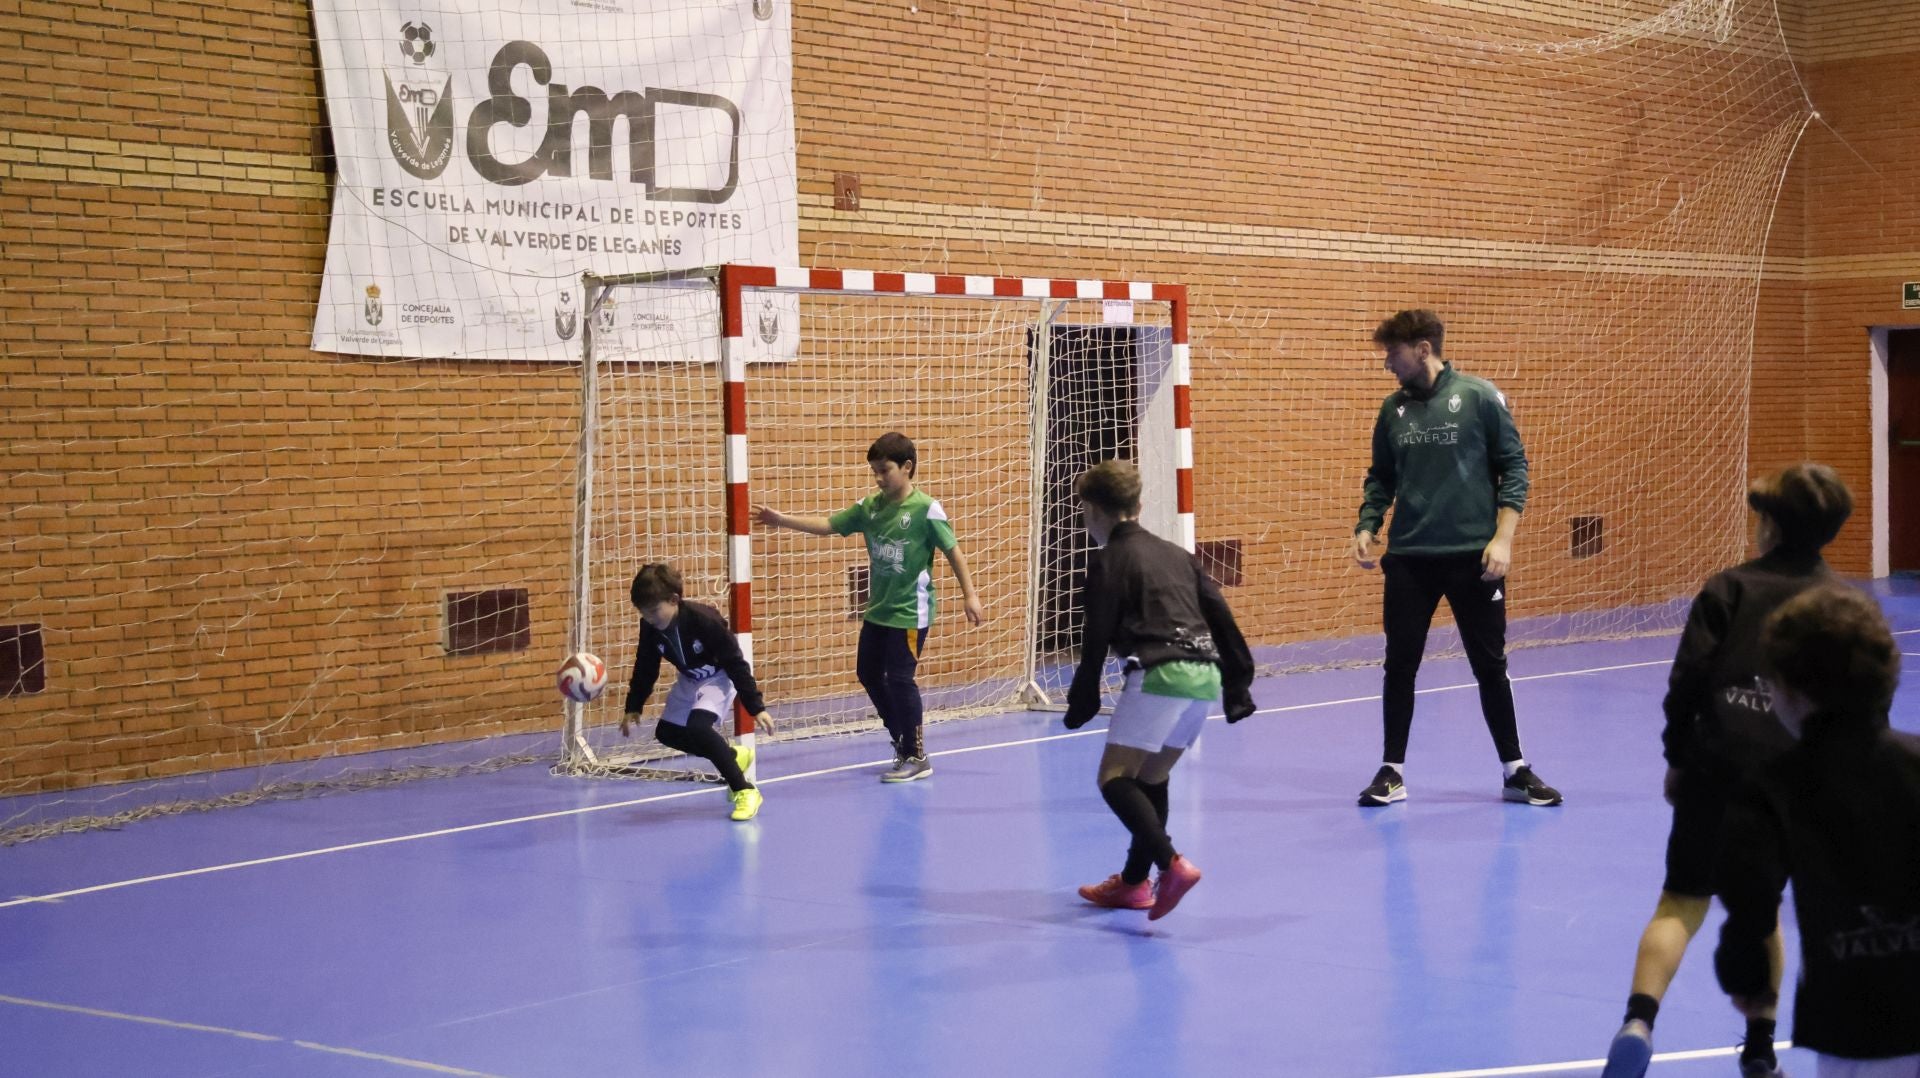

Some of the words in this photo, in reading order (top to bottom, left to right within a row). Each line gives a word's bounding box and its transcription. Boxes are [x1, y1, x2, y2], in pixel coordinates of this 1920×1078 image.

[390, 130, 420, 168] Valverde
[373, 188, 475, 213] ESCUELA
[486, 199, 600, 222] MUNICIPAL
[610, 207, 634, 224] DE
[644, 209, 743, 230] DEPORTES
[450, 226, 469, 243] DE
[475, 228, 571, 250] VALVERDE
[576, 235, 598, 252] DE
[603, 235, 683, 256] LEGANÉS
[401, 315, 412, 323] DE
[413, 315, 455, 324] DEPORTES
[340, 335, 369, 343] Valverde
[1397, 431, 1458, 445] VALVERDE
